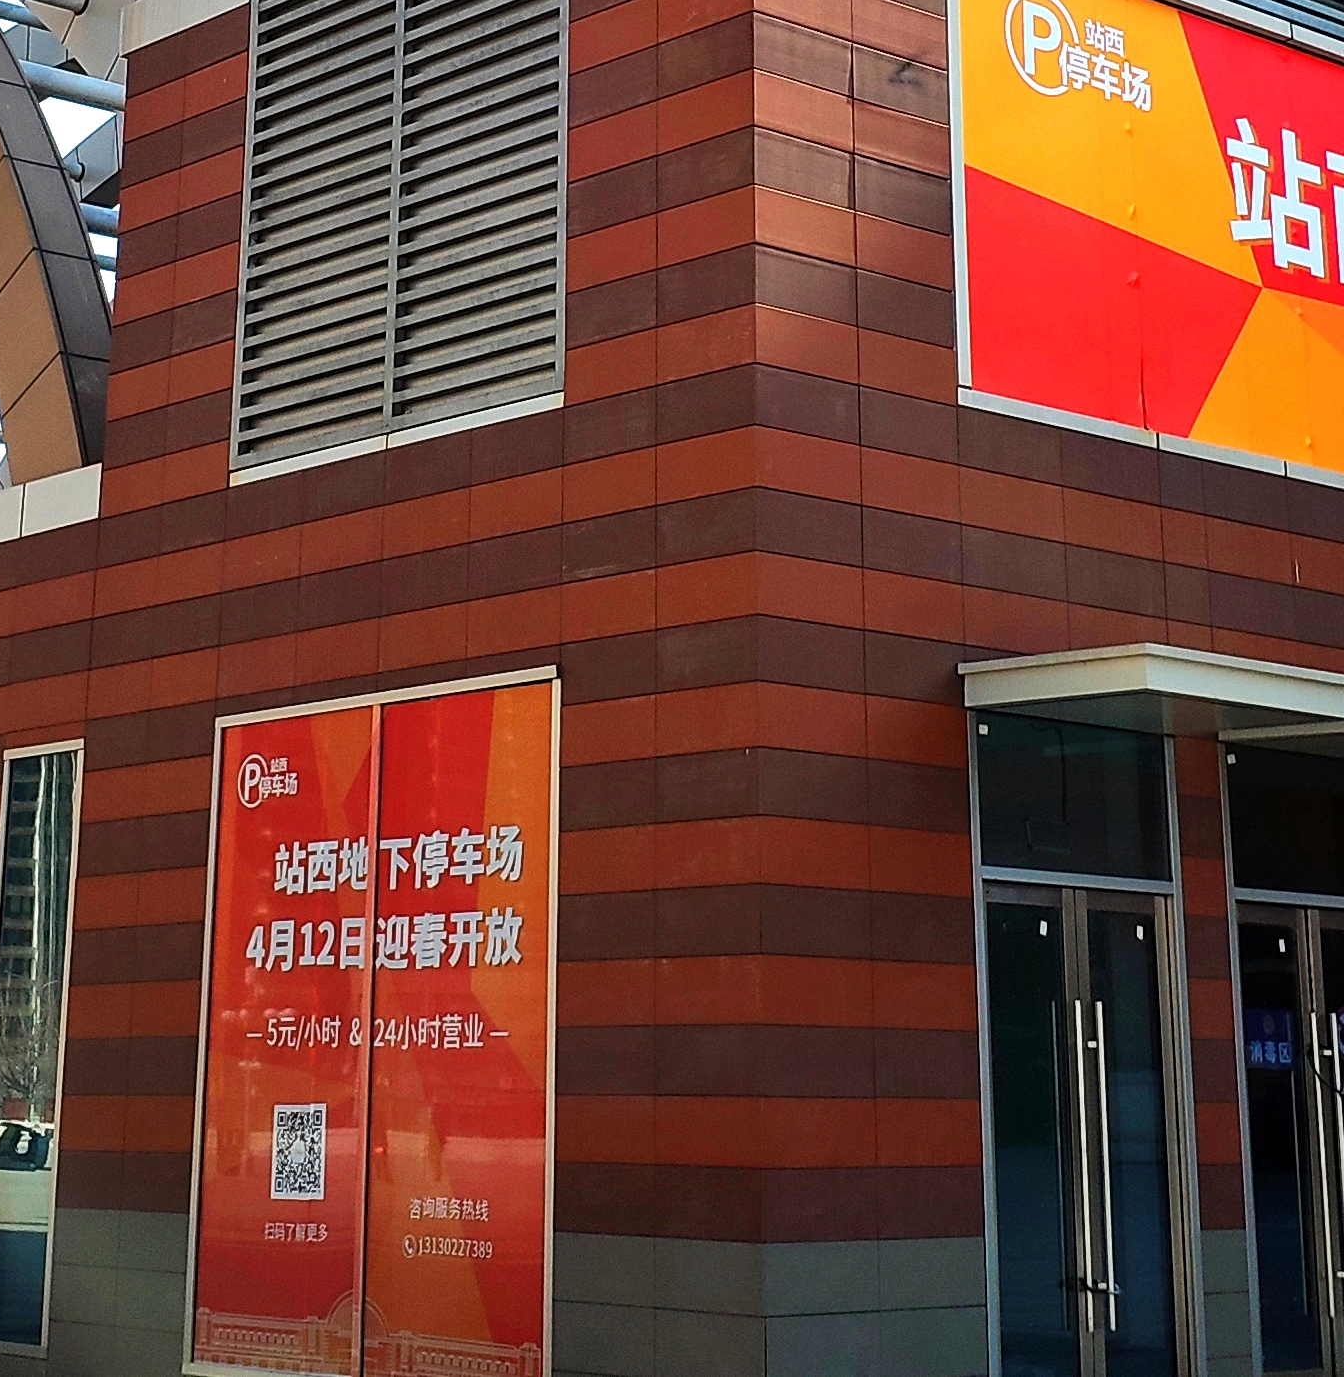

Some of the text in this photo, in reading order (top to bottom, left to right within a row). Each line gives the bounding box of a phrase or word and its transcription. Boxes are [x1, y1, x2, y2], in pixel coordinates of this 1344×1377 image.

[1084, 18, 1125, 57] 站西
[1058, 43, 1152, 112] 停车场
[259, 772, 298, 799] 停车场
[274, 825, 524, 896] 站西地下停车场
[245, 907, 523, 972] 4月12日迎春开放
[267, 1014, 342, 1051] 5元/小时
[374, 1013, 484, 1051] 24小时营业
[1250, 1040, 1292, 1063] 消毒区
[409, 1197, 490, 1222] 咨询服务热线
[264, 1222, 329, 1243] 扫码了解更多
[418, 1236, 493, 1259] 13130227389
